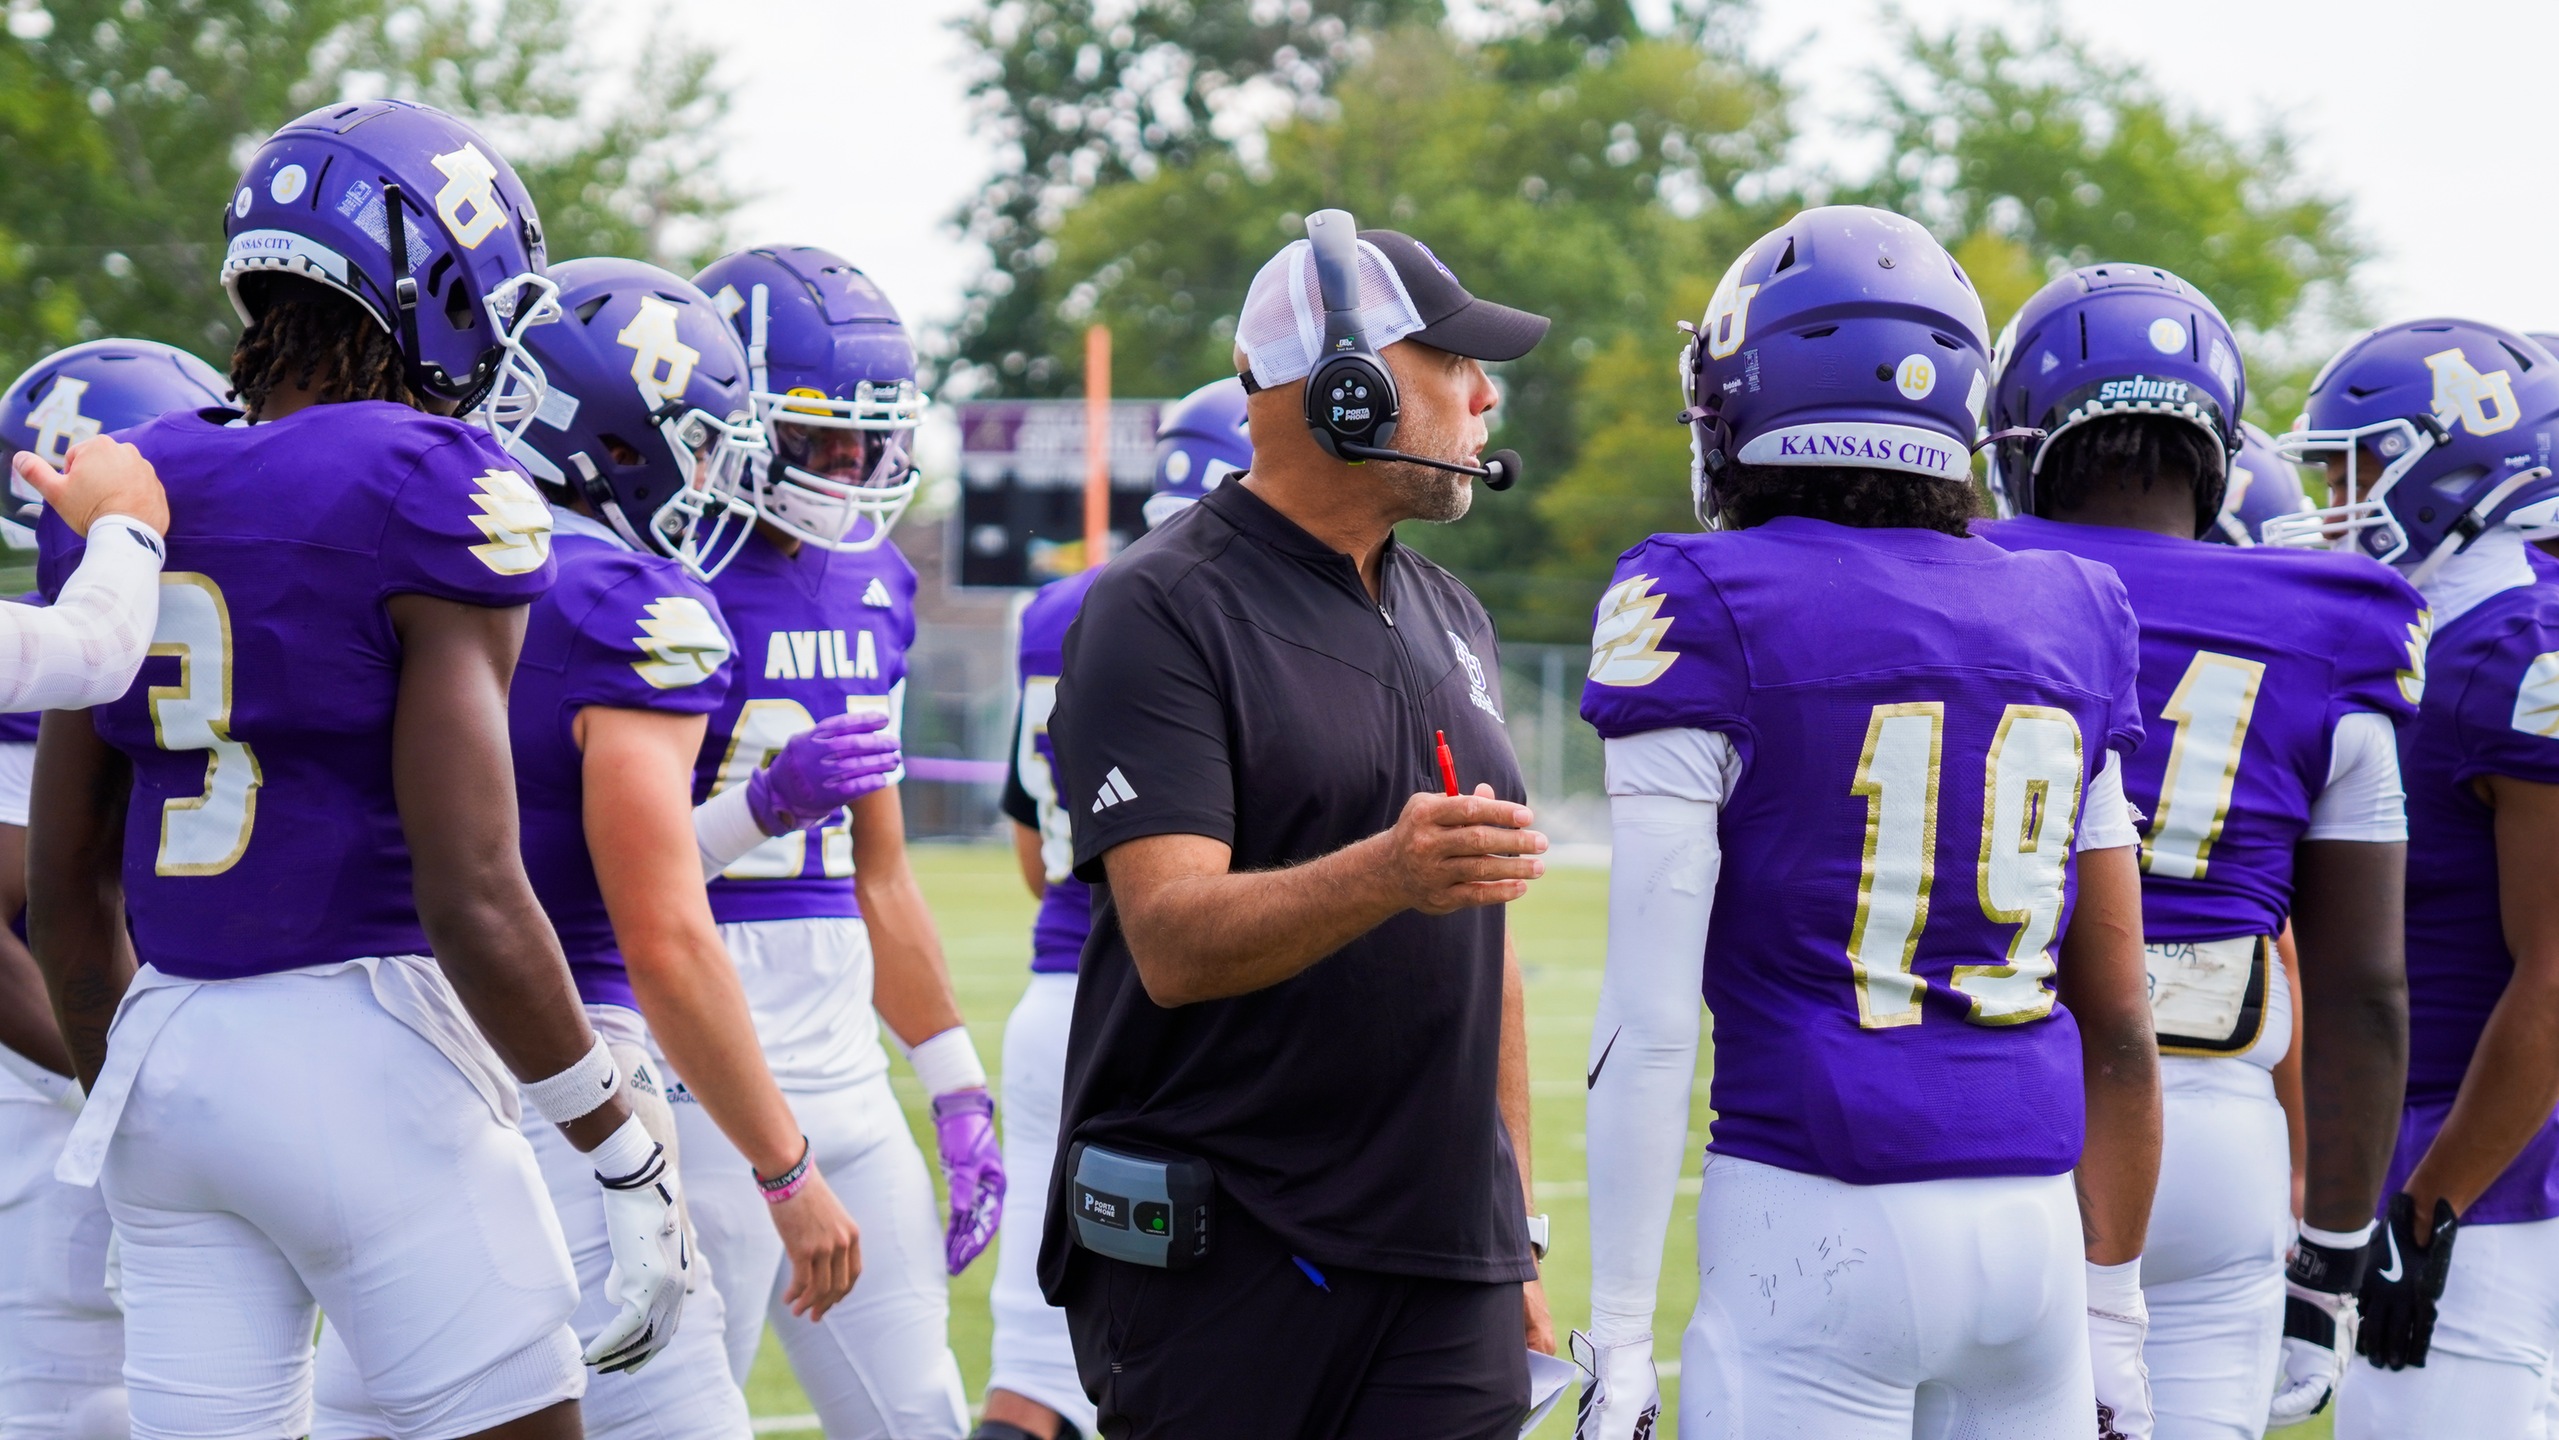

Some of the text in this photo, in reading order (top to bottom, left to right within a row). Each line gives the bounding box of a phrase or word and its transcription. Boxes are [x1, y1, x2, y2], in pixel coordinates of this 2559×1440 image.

[264, 237, 294, 250] CITY
[1902, 361, 1929, 392] 19
[2099, 374, 2189, 403] schutt
[1345, 407, 1370, 416] PORTA
[1345, 413, 1370, 421] PHONE
[1779, 435, 1952, 471] KANSAS CITY
[764, 630, 879, 680] AVILA
[146, 571, 263, 876] 3
[1846, 701, 2083, 1028] 19
[1094, 1200, 1116, 1212] PORTA
[1094, 1206, 1116, 1218] PHONE
